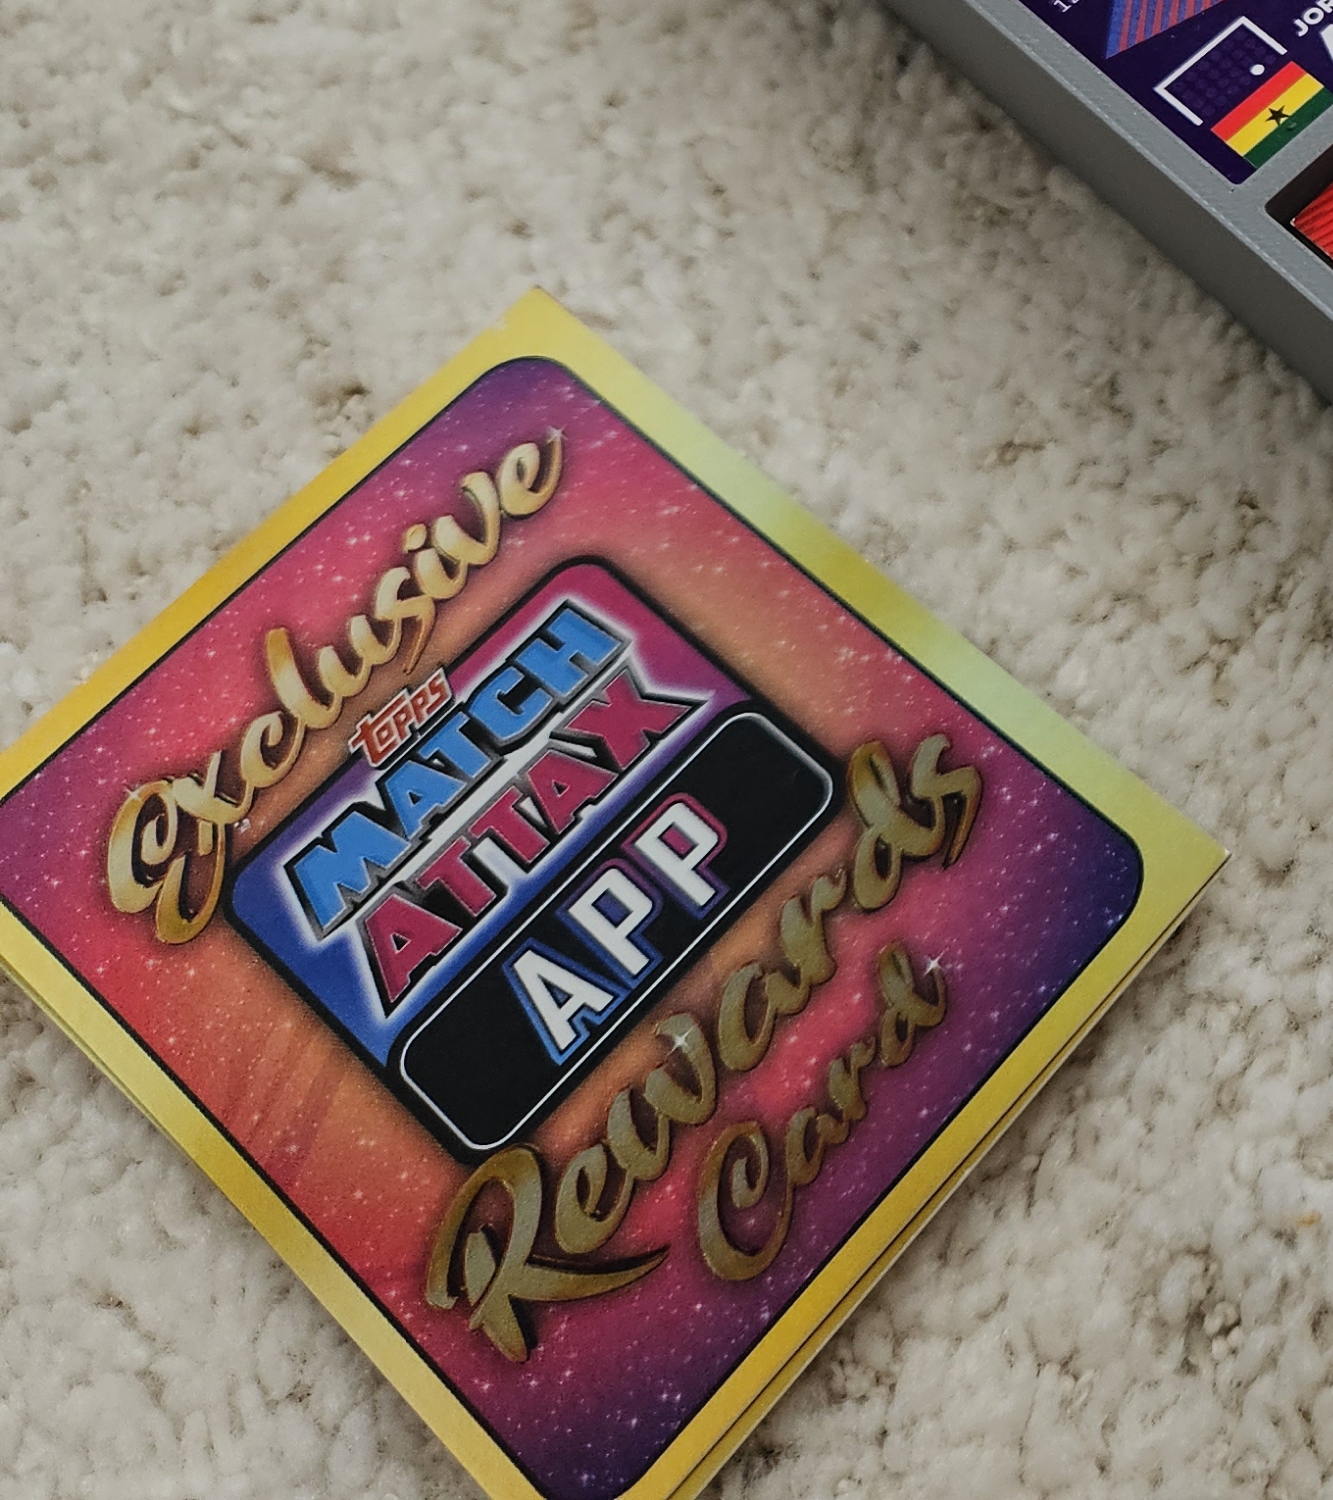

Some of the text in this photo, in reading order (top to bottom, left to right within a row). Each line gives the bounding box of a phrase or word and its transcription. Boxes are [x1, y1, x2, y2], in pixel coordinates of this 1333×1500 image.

[107, 430, 564, 944] Exclusive
[284, 598, 633, 937] MATCH
[360, 667, 709, 1010] ATTAX
[427, 734, 983, 1364] Rewards
[504, 793, 728, 1065] APP
[698, 941, 949, 1283] Card
